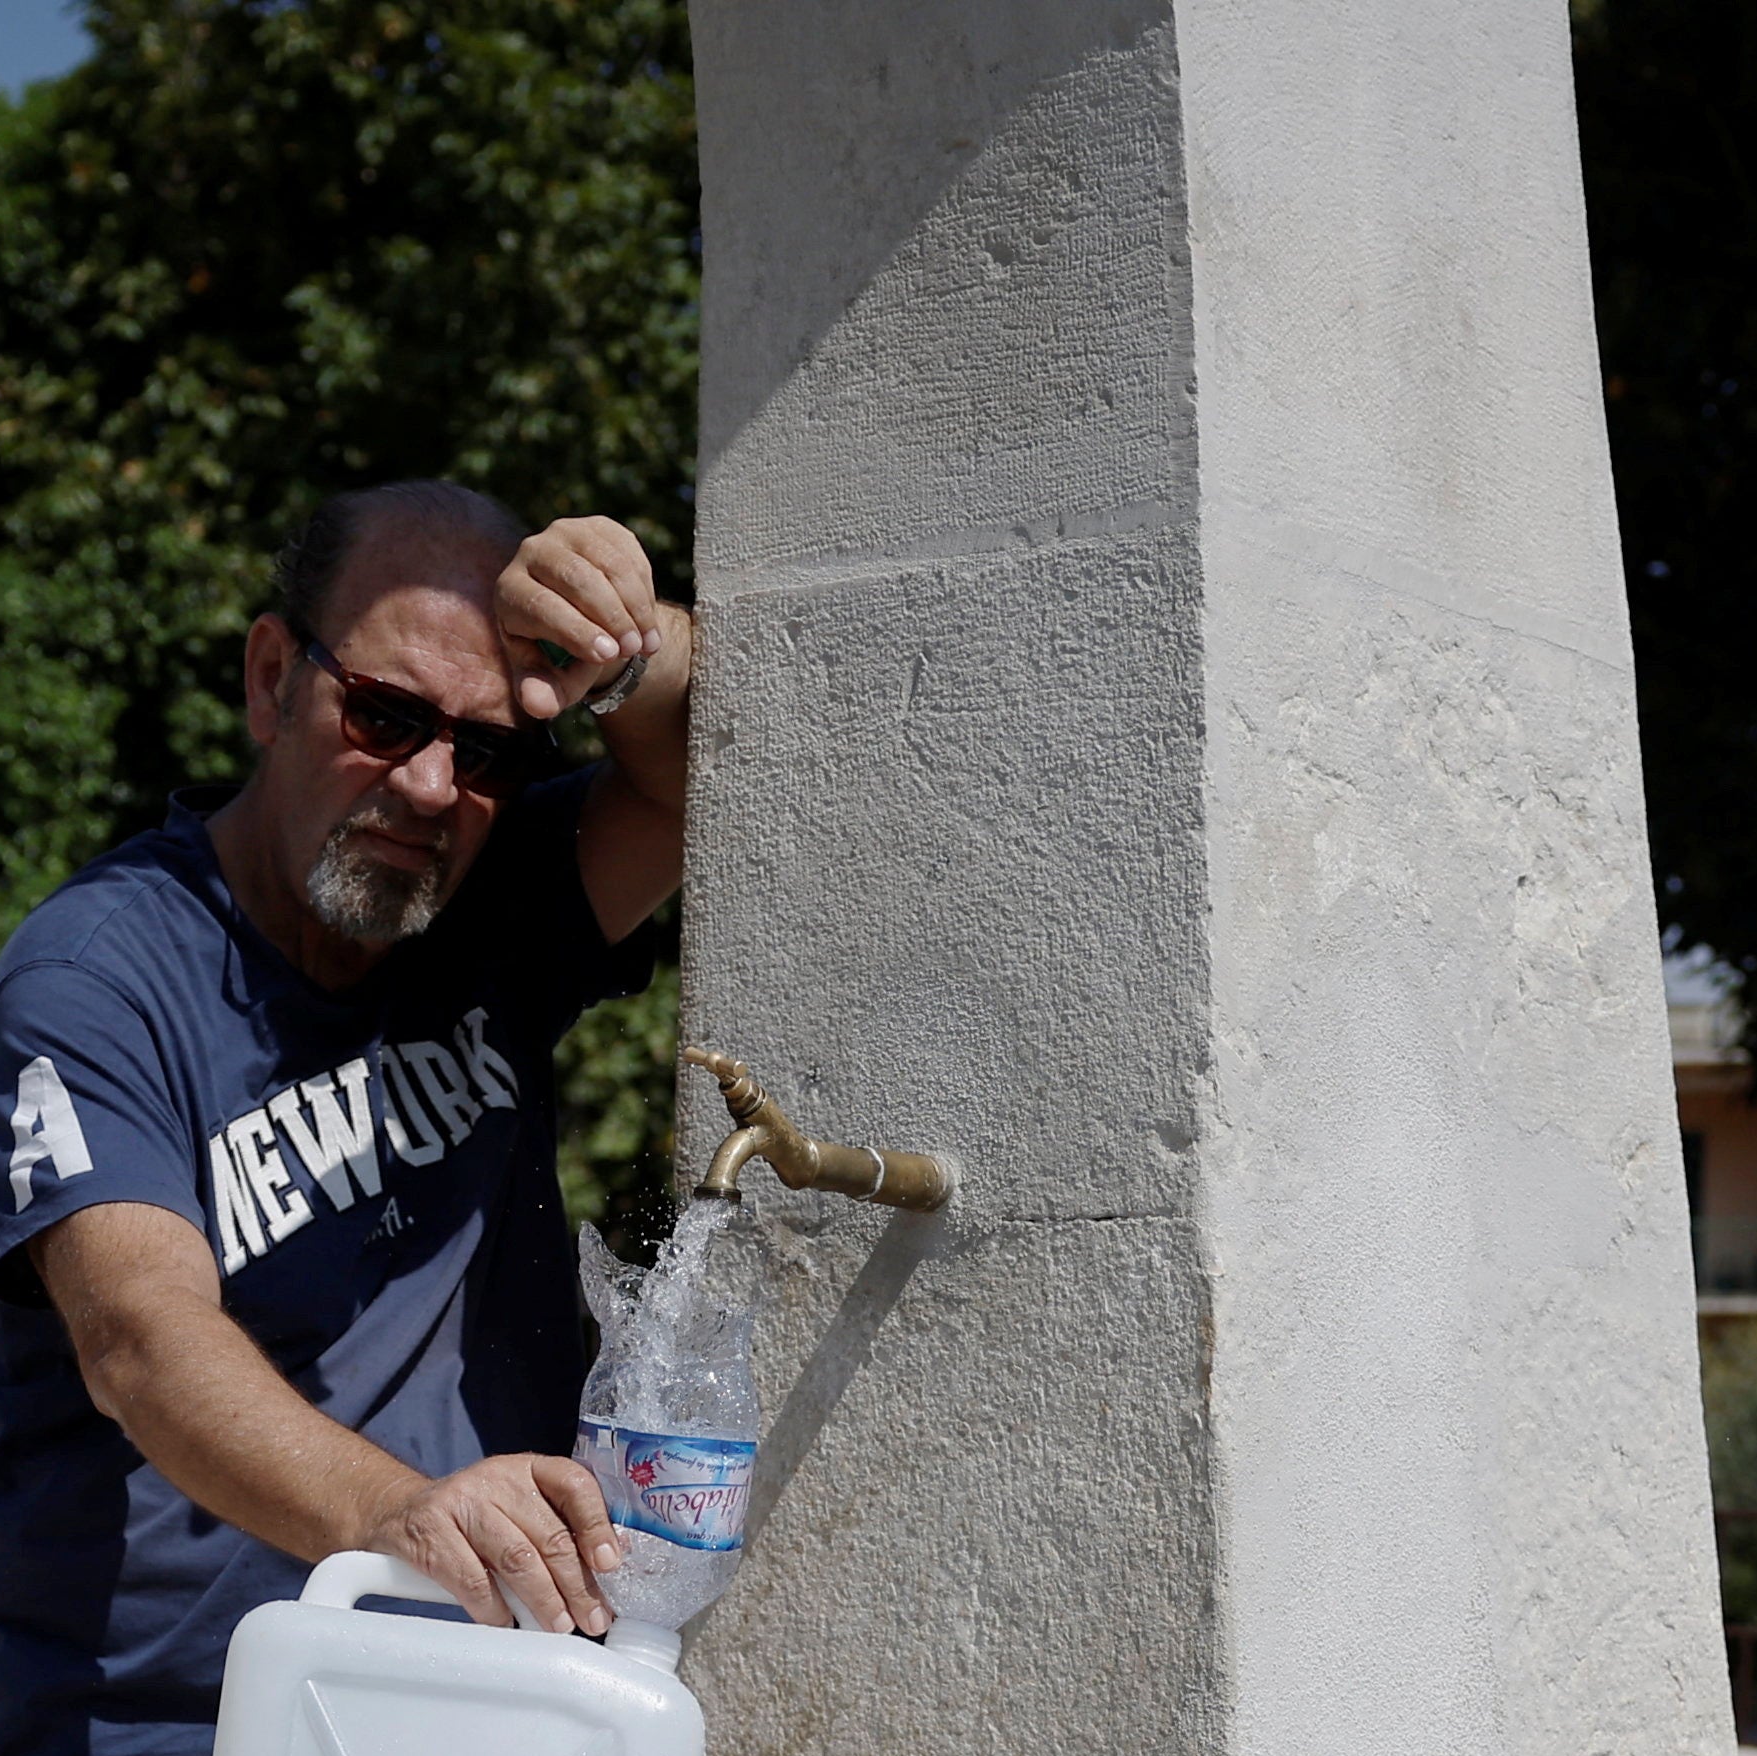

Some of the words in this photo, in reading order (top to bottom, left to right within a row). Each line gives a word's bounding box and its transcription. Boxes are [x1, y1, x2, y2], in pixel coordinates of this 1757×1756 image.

[8, 1055, 94, 1214] A
[208, 1056, 383, 1278] NEW
[378, 1006, 520, 1169] ORK
[647, 1474, 750, 1536] Vitabella
